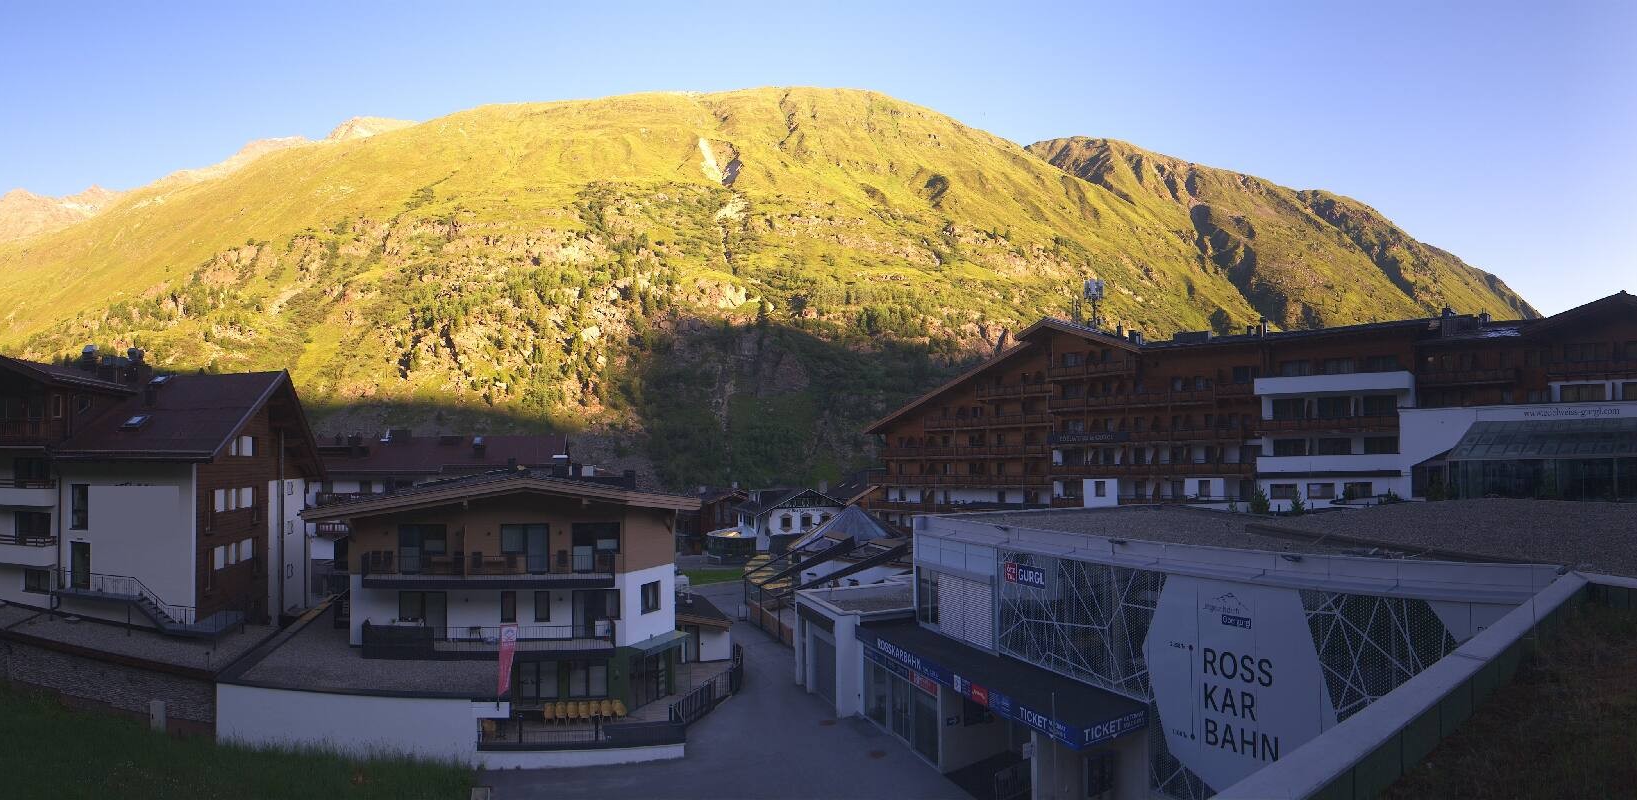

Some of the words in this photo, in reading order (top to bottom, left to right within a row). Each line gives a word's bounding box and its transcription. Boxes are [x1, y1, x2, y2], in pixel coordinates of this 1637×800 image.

[1018, 568, 1045, 586] GURGL
[876, 637, 921, 670] ROSSKARBAHN
[1203, 647, 1274, 688] ROSS
[1019, 706, 1048, 730] TICKET
[1203, 682, 1257, 722] KAR
[1083, 717, 1124, 742] TICKET
[1204, 717, 1280, 762] BAHN
